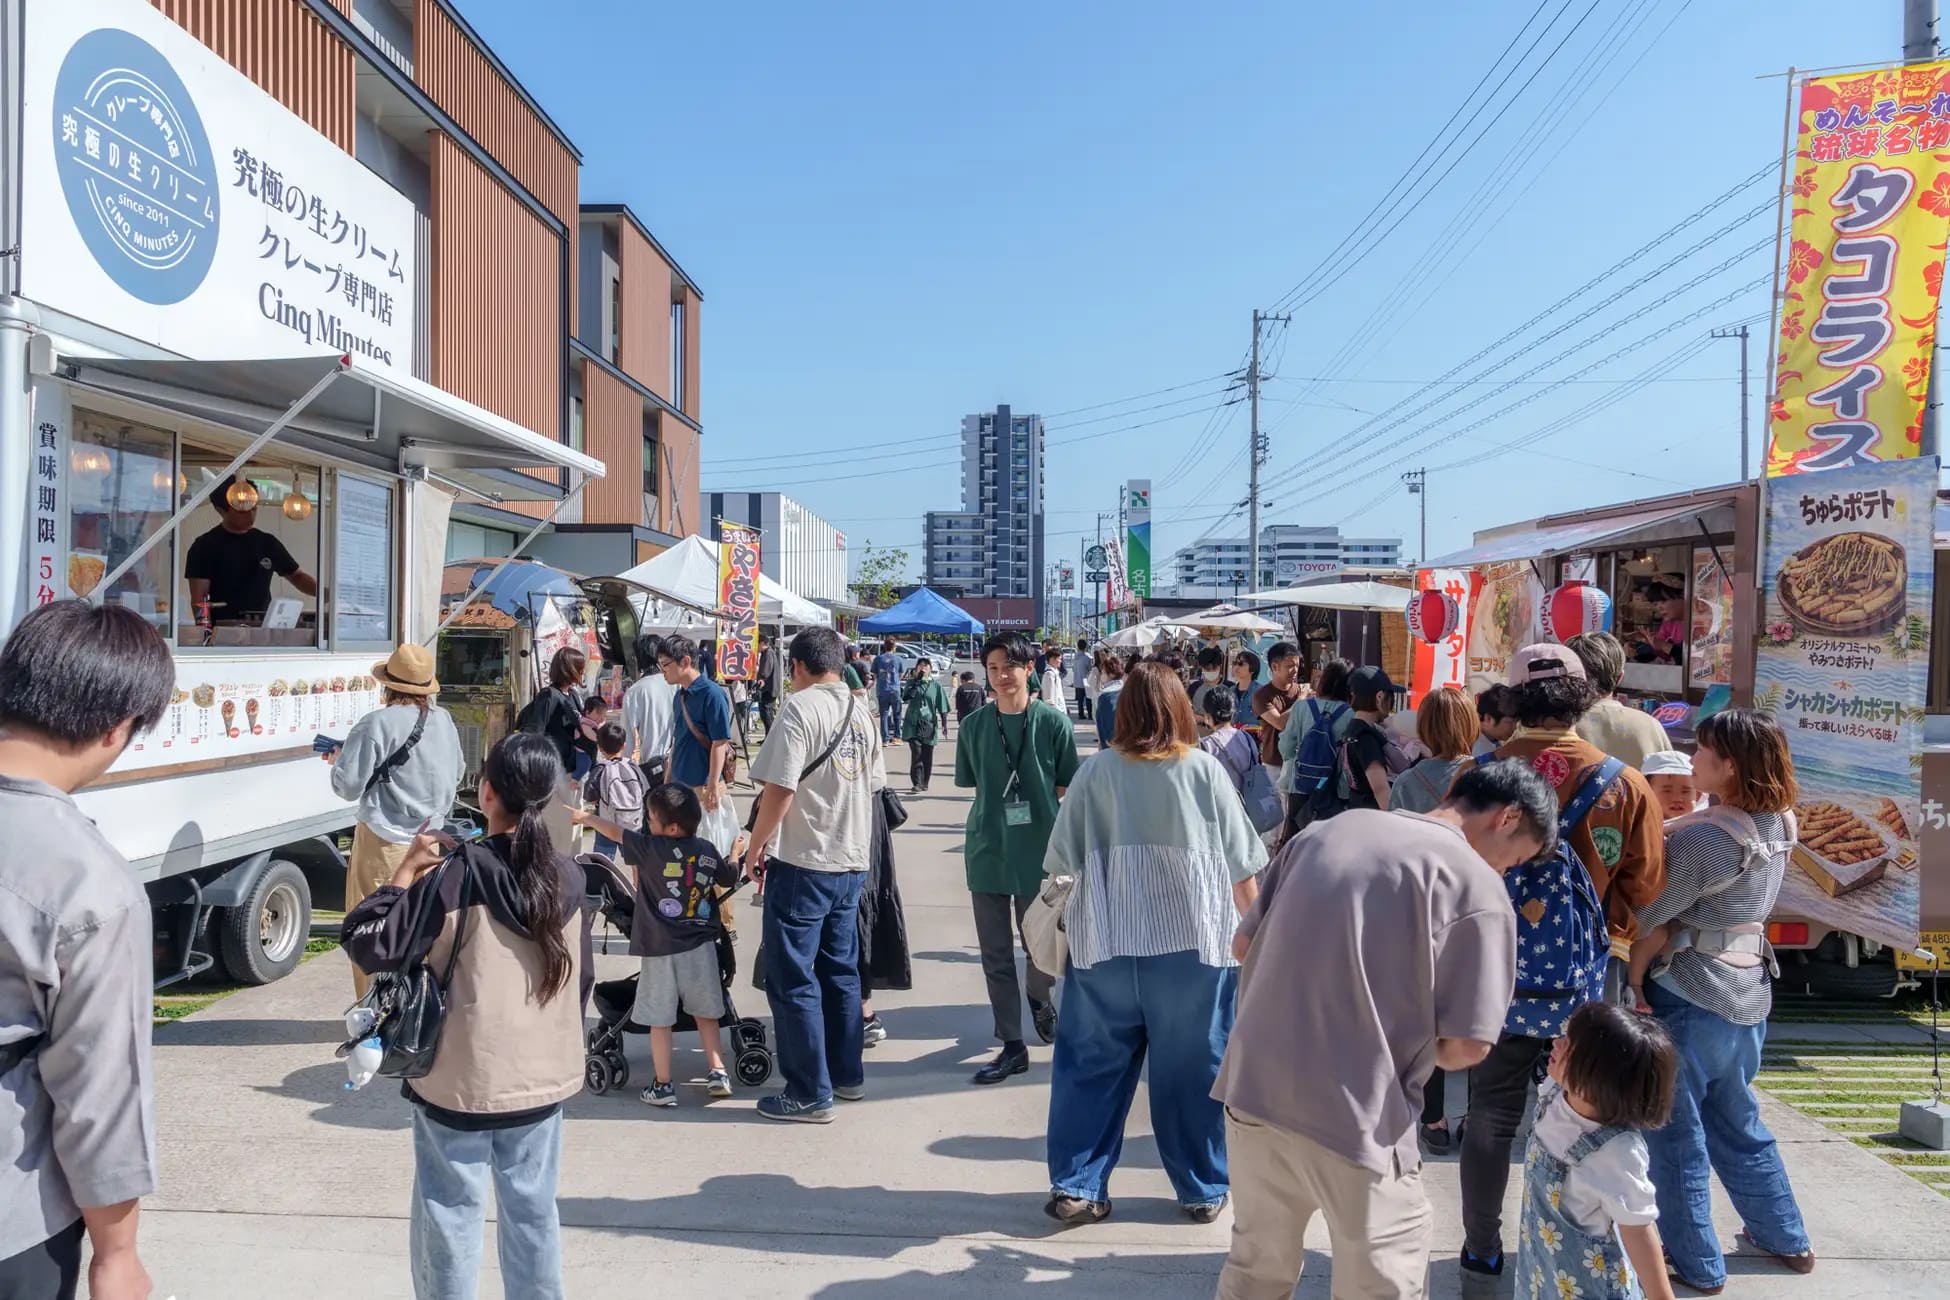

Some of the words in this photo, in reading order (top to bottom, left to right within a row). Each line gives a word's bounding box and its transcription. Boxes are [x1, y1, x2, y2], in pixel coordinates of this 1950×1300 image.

[1811, 119, 1950, 163] 琉球名物
[62, 113, 214, 222] 究極の生クリーム
[105, 196, 131, 237] CINQ
[133, 229, 179, 251] MINUTES
[118, 193, 144, 215] since
[146, 205, 169, 228] 2011
[232, 146, 404, 284] 究極の生クリーム
[258, 224, 394, 327] クレープ専門店
[258, 282, 312, 345] Cinq
[1800, 164, 1916, 468] タコライス
[1800, 489, 1896, 526] ちゅらポテト
[1297, 563, 1337, 572] TOYOTA
[720, 543, 757, 677] やきそば
[1409, 600, 1421, 630] Orion
[1540, 594, 1553, 636] Orion
[1800, 639, 1881, 655] オリジナルタコミートの
[1808, 653, 1874, 671] やみつきポテト!
[1652, 707, 1688, 721] OPEN
[1784, 688, 1908, 726] シャカシャカポテト
